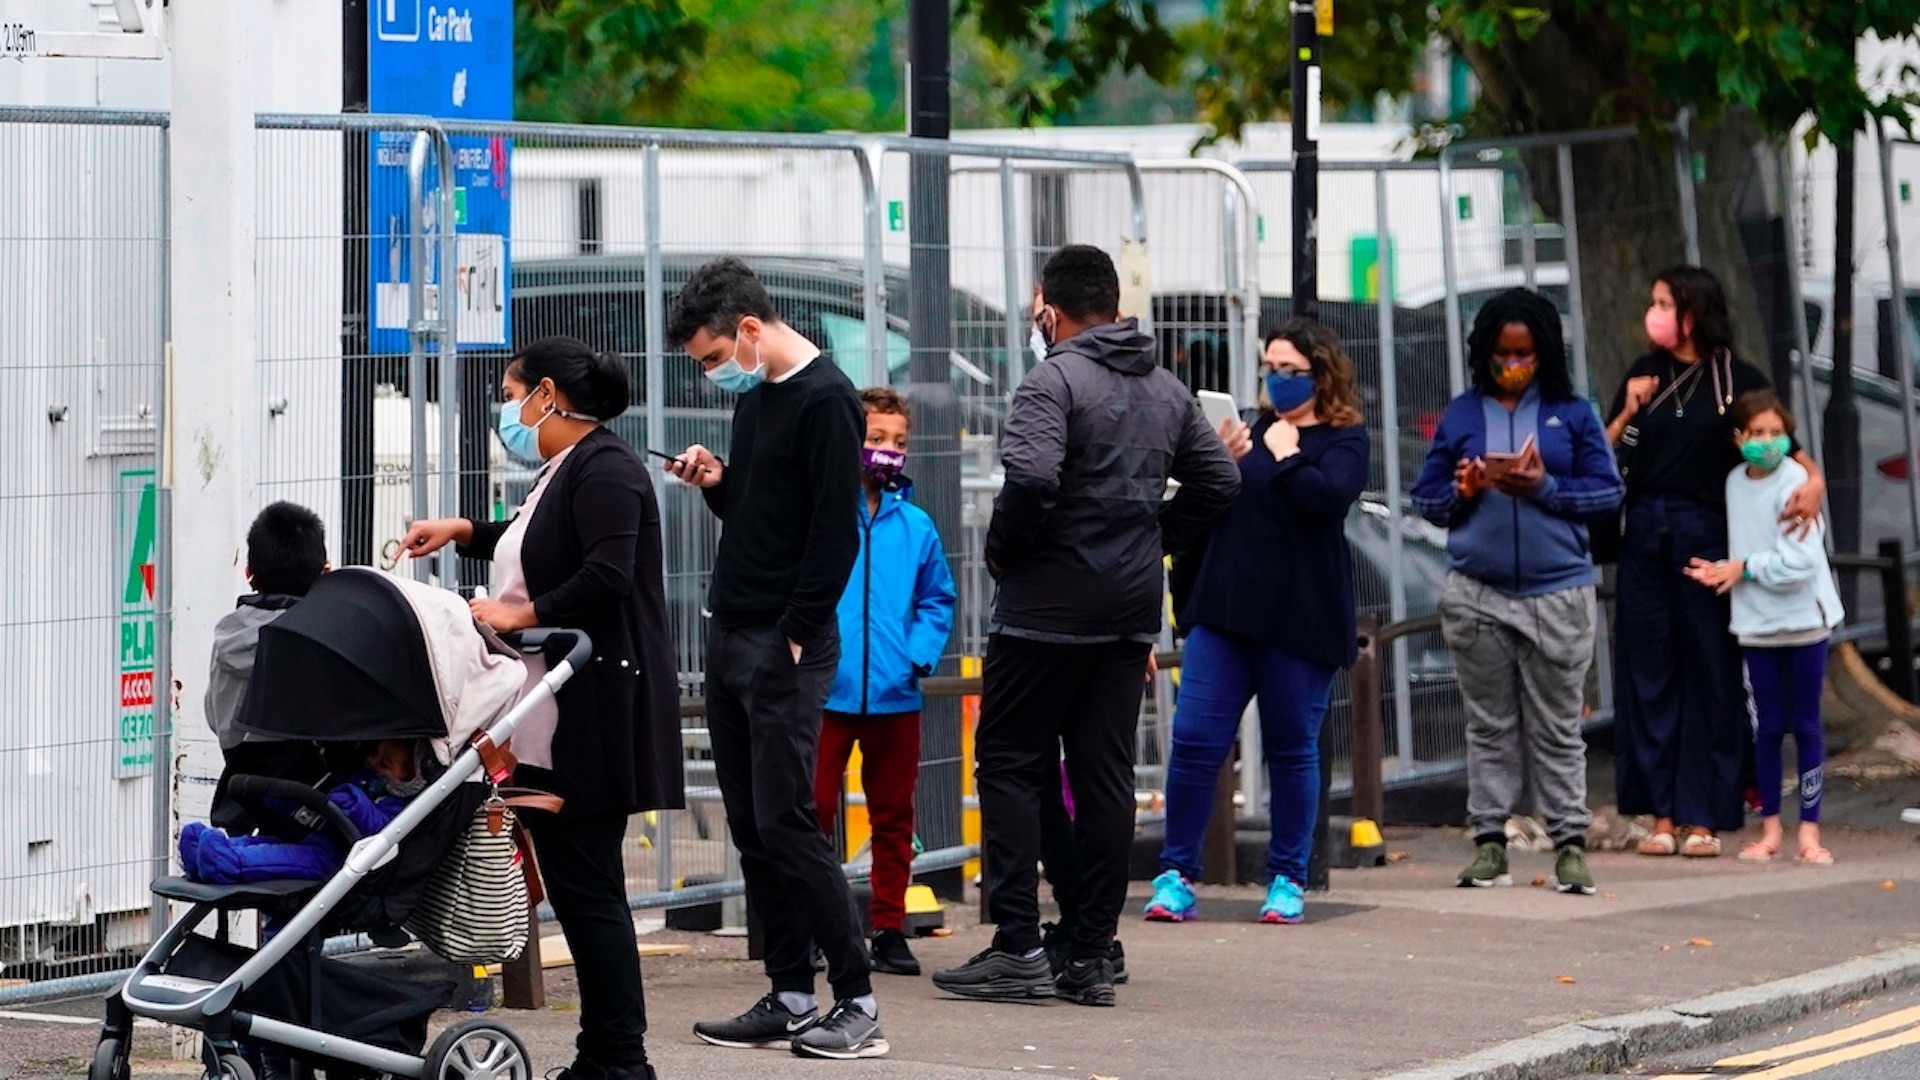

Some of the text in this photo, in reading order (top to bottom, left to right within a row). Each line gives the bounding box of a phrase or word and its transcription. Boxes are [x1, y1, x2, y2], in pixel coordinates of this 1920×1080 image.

[4, 23, 36, 52] 2.05m
[428, 6, 446, 41] Car
[448, 7, 473, 42] Park
